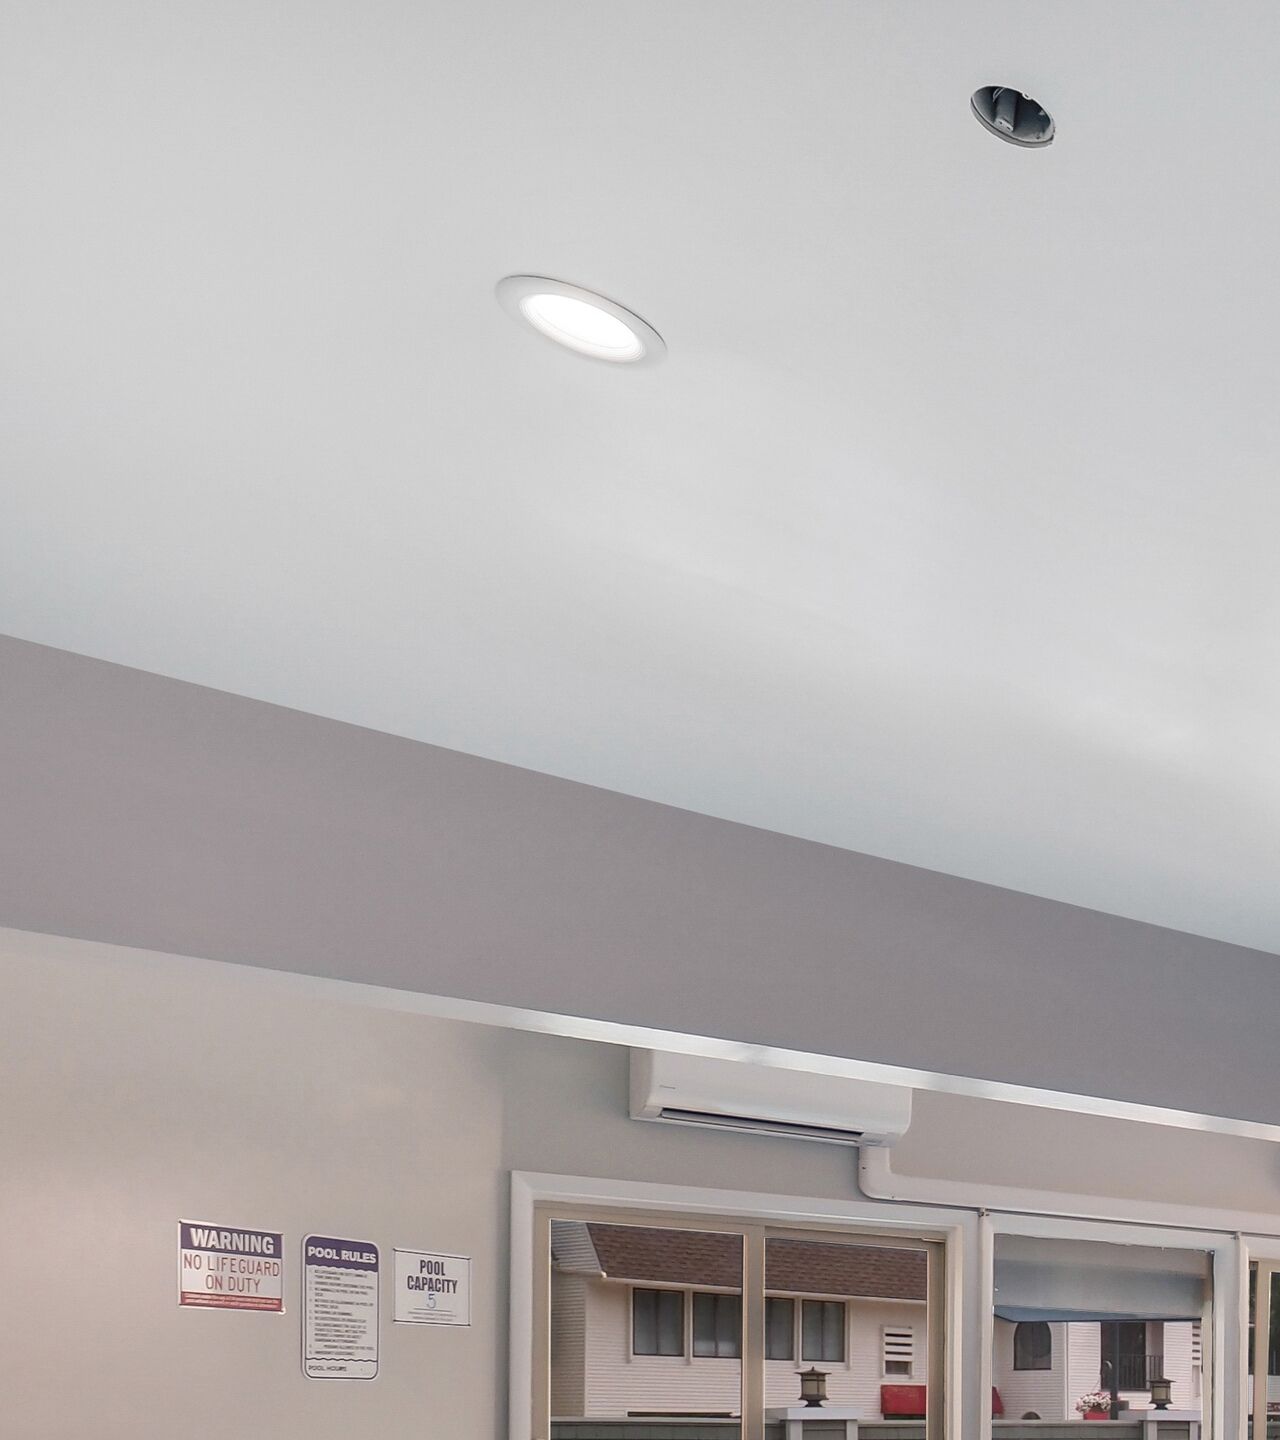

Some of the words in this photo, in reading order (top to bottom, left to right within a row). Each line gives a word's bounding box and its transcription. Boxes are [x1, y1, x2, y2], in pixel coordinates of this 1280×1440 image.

[190, 1228, 274, 1254] WARNING
[308, 1246, 339, 1261] POOL
[341, 1250, 376, 1264] RULES
[183, 1253, 202, 1270] NO
[207, 1256, 280, 1277] LIFEGUARD
[420, 1260, 446, 1276] POOL
[205, 1275, 223, 1291] ON
[228, 1276, 261, 1293] DUTY
[407, 1276, 458, 1294] CAPACITY
[426, 1293, 437, 1309] 5
